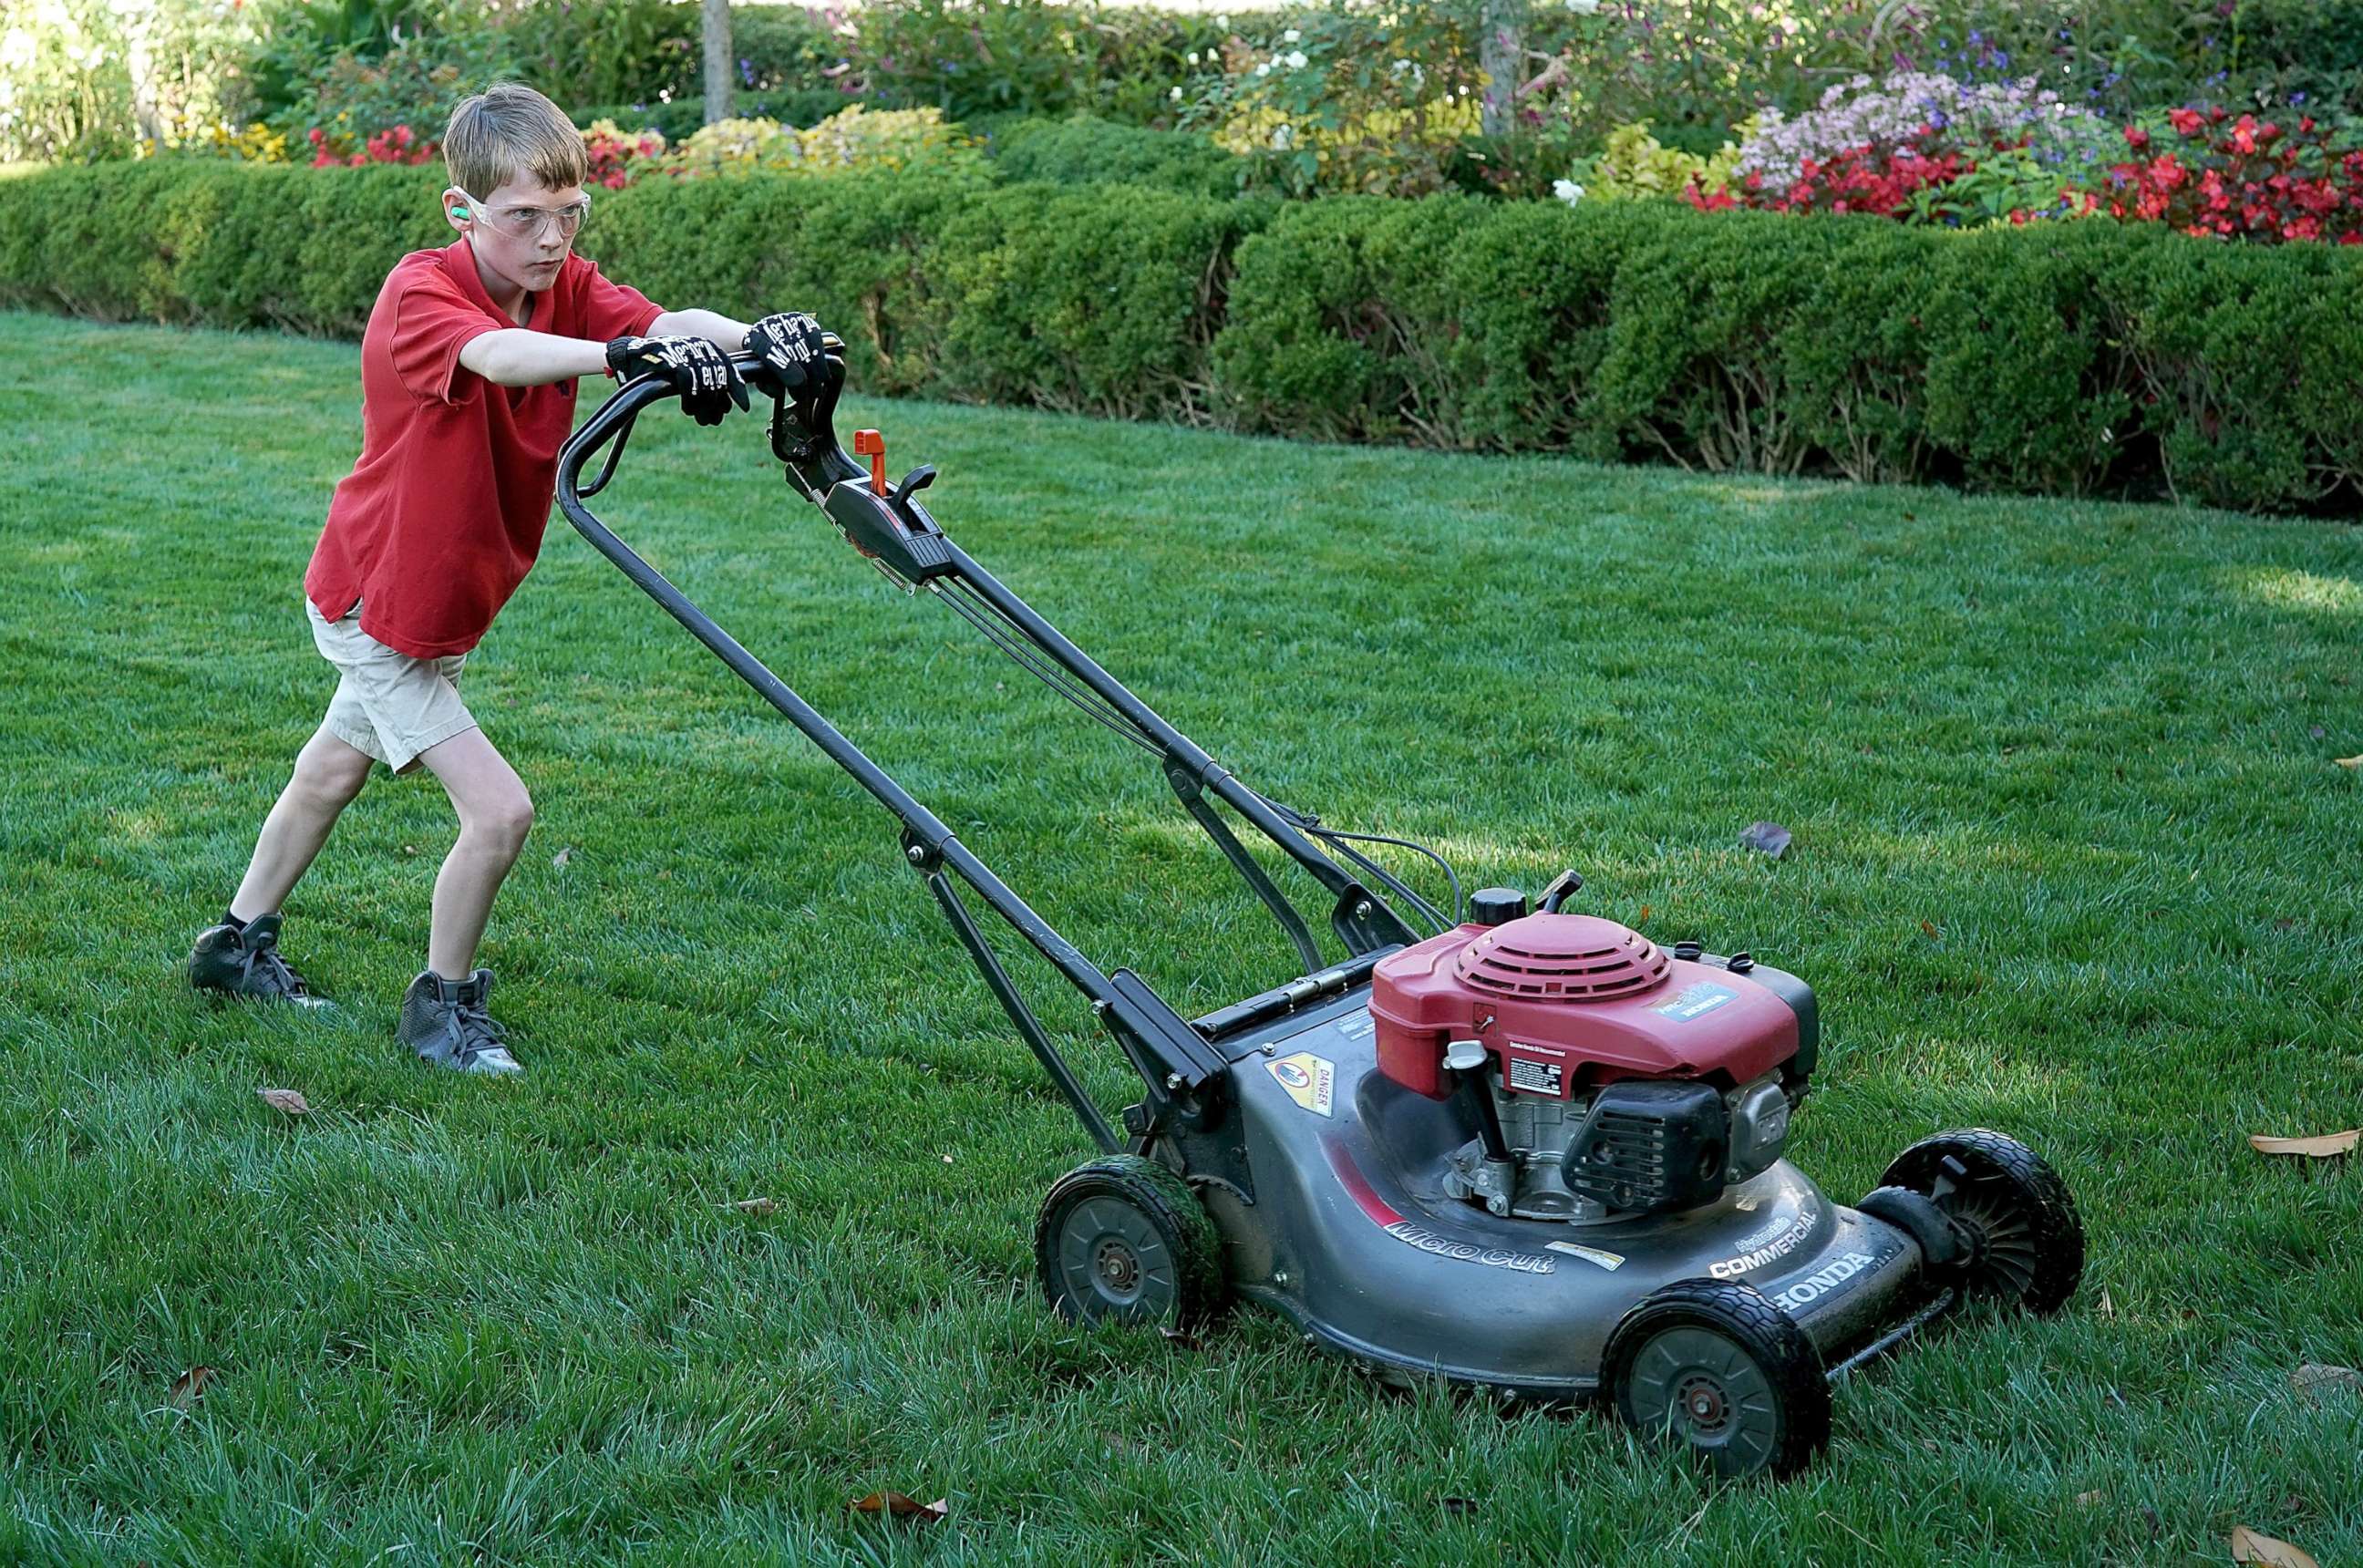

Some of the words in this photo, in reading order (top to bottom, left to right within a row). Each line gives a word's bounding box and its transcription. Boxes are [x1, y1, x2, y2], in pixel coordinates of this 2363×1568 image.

[1317, 1068, 1330, 1106] DANGER
[1383, 1221, 1481, 1260] Micro
[1481, 1248, 1554, 1274] Cut
[1708, 1212, 1817, 1278] COMMERCIAL
[1770, 1252, 1874, 1312] HONDA
